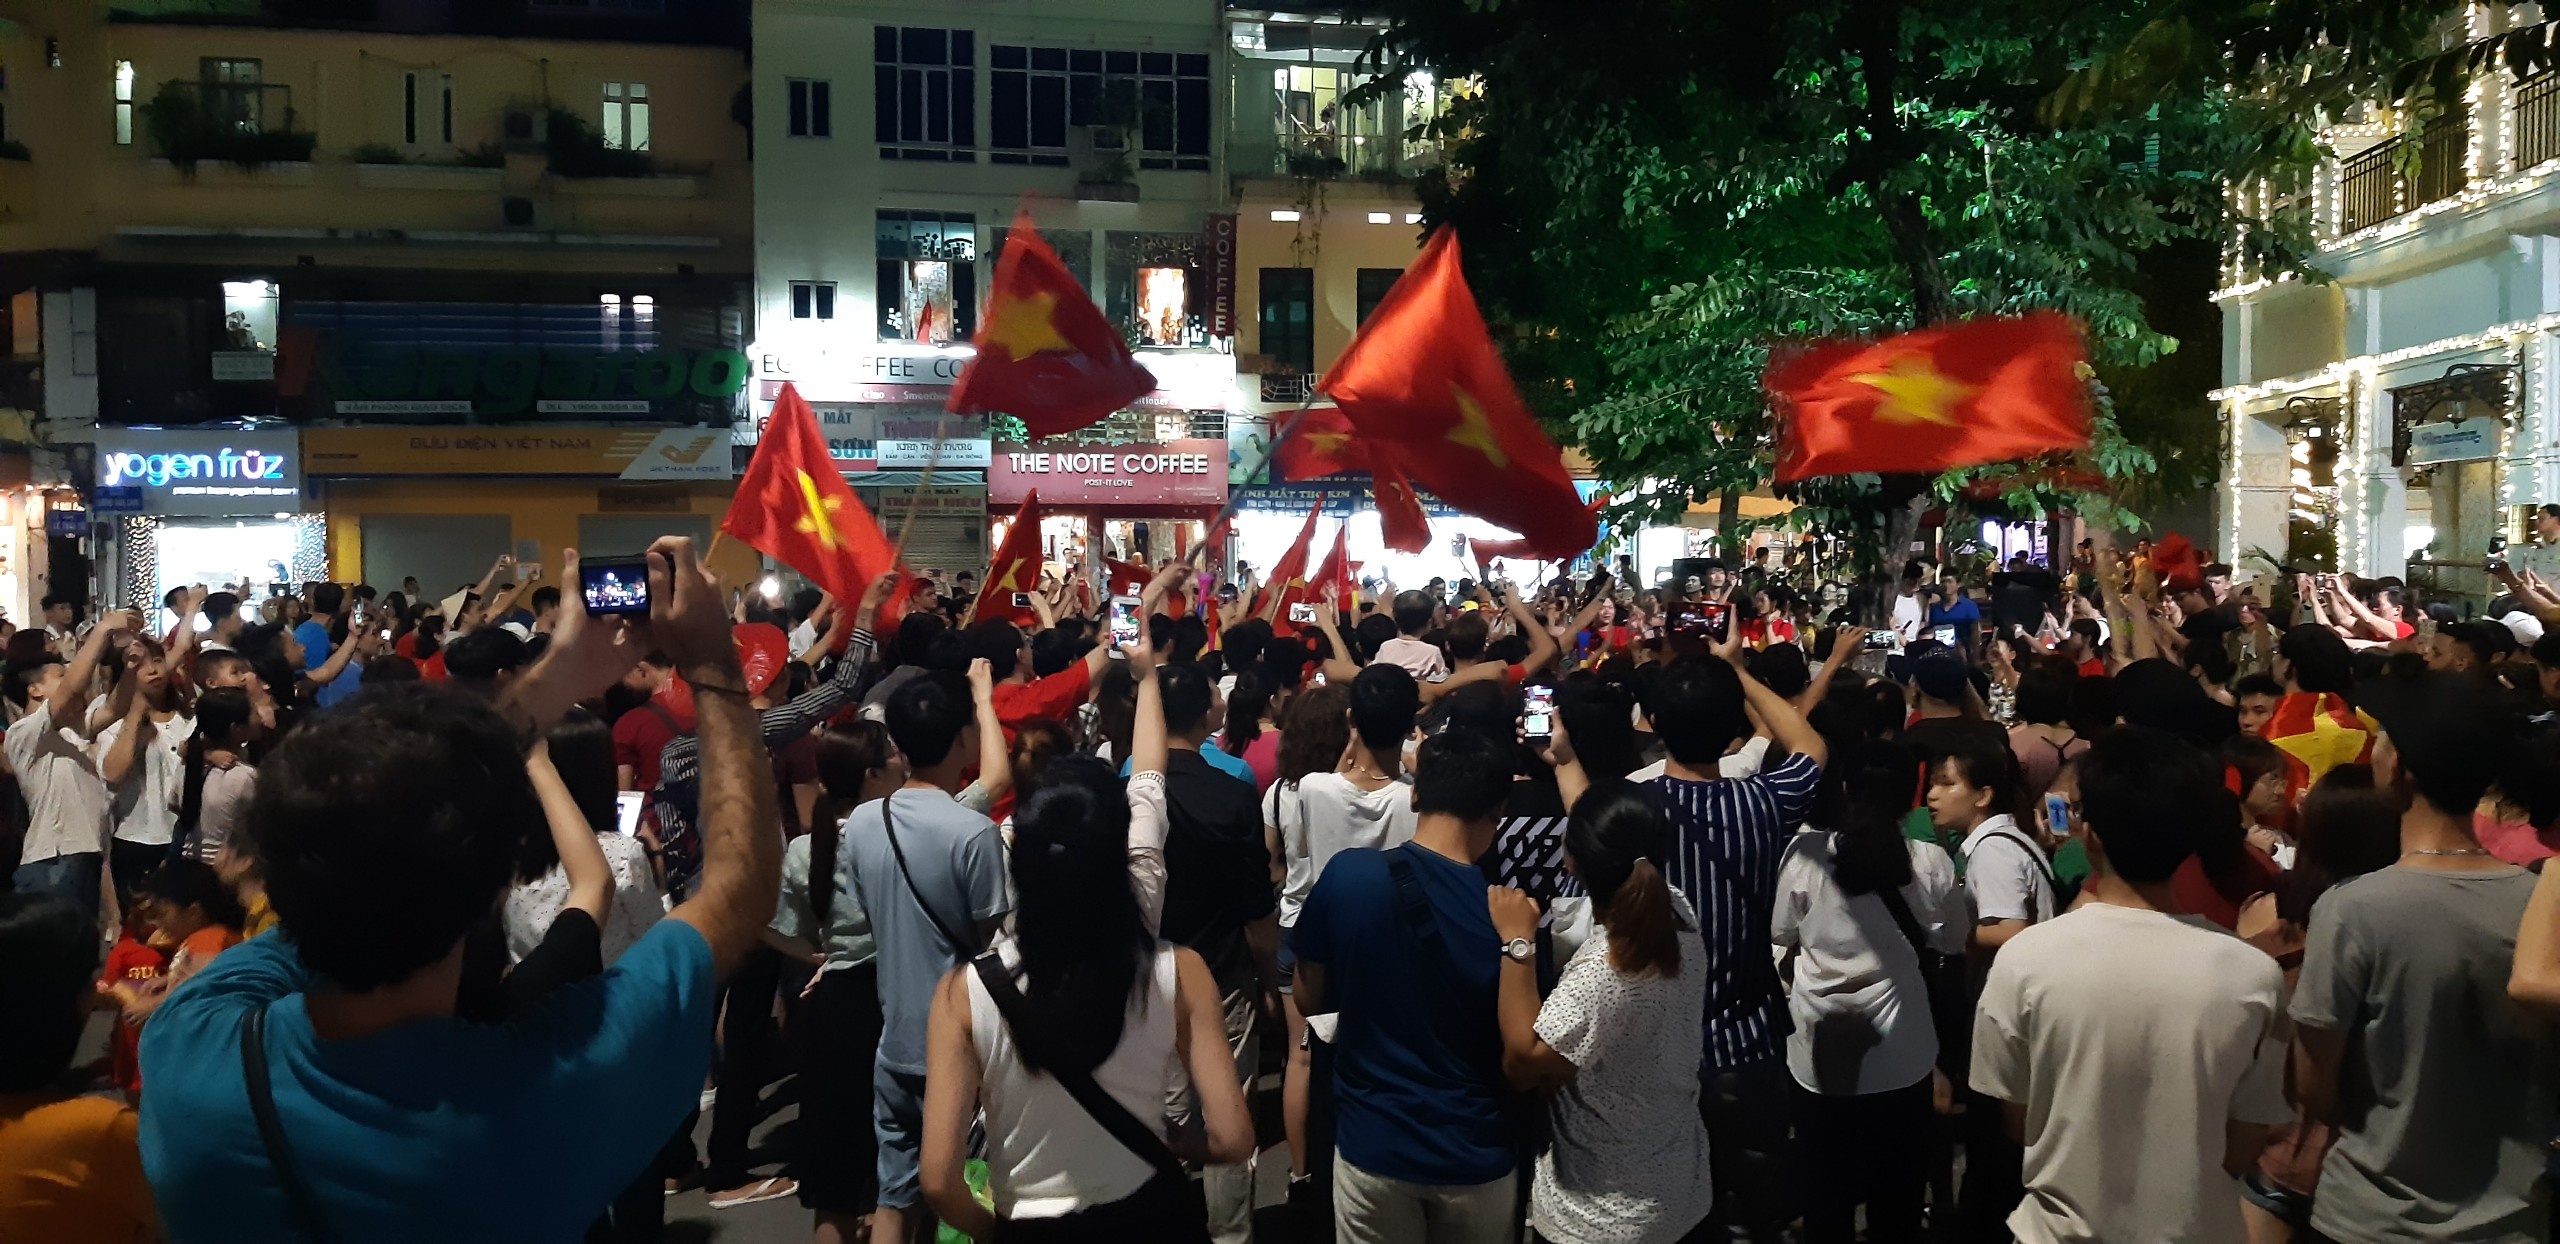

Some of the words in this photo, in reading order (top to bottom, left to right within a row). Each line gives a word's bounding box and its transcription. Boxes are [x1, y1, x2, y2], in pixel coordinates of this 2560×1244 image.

[1215, 219, 1231, 332] COFFEE
[550, 437, 592, 450] NAM
[104, 451, 215, 487] yogen
[218, 446, 285, 480] früz
[1008, 453, 1050, 475] THE
[1056, 453, 1116, 475] NOTE
[1122, 453, 1210, 476] COFFEE
[1112, 478, 1134, 488] LOVE
